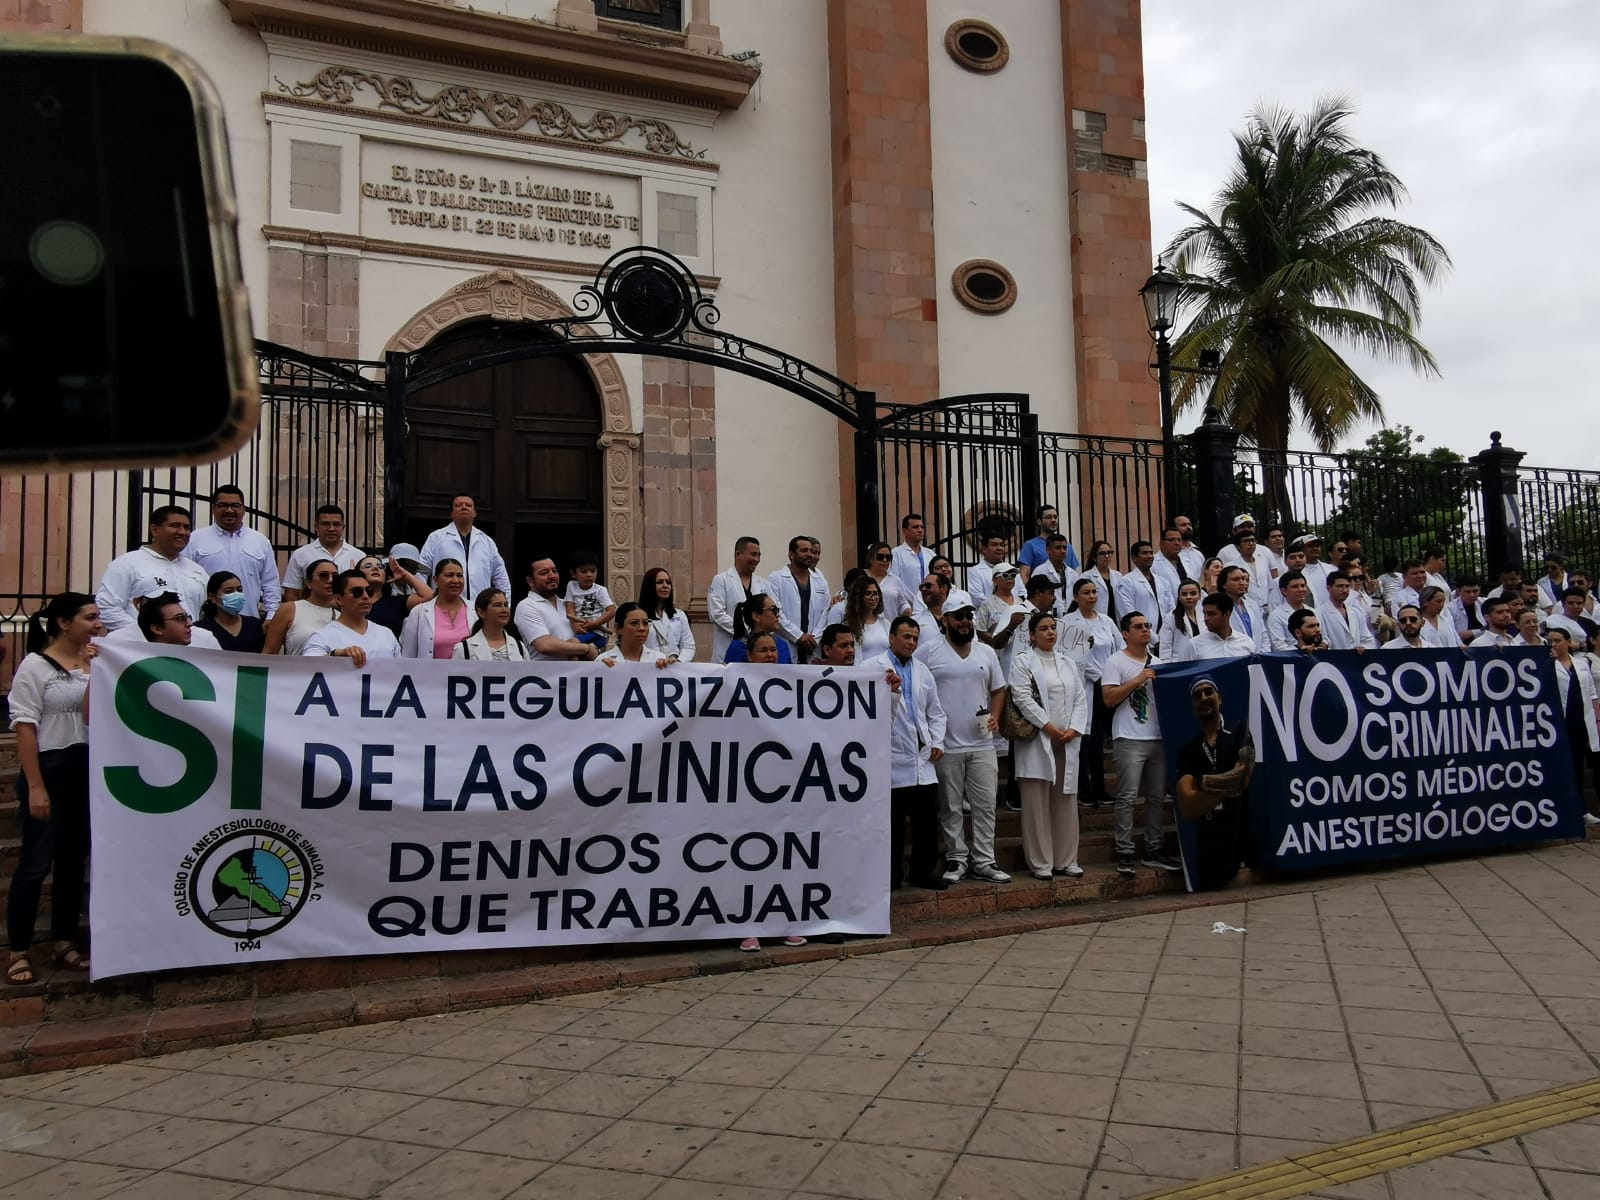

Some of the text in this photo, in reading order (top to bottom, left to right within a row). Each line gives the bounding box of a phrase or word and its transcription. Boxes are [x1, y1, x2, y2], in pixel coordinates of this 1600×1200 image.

[361, 182, 412, 204] GARZA
[416, 189, 427, 205] Y
[430, 191, 533, 218] BALLESTEROS
[604, 212, 639, 231] ESTE
[573, 189, 592, 205] DE
[595, 192, 614, 209] LA
[387, 207, 449, 228] TEMPLO
[475, 219, 494, 235] 22
[497, 221, 516, 239] DE
[519, 223, 556, 242] MAYO
[558, 228, 576, 245] DE
[579, 230, 611, 249] 1842
[295, 667, 877, 720] A LA REGULARIZACIÓN
[1363, 658, 1541, 706] SOMOS
[103, 656, 269, 814] SI
[1248, 661, 1358, 763] NO
[1360, 703, 1557, 761] CRIMINALES
[301, 721, 868, 811] DE LAS CLÍNICAS
[1289, 759, 1544, 808] SOMOS MÉDICOS
[191, 818, 287, 857] ANESTESIOLOGOS
[286, 828, 302, 842] DE
[1276, 798, 1558, 856] ANESTESIÓLOGOS
[180, 854, 196, 870] DE
[388, 831, 821, 883] DENNOS CON
[174, 871, 190, 917] COLEGIO
[367, 882, 832, 938] QUE TRABAJAR
[234, 940, 261, 952] 1994
